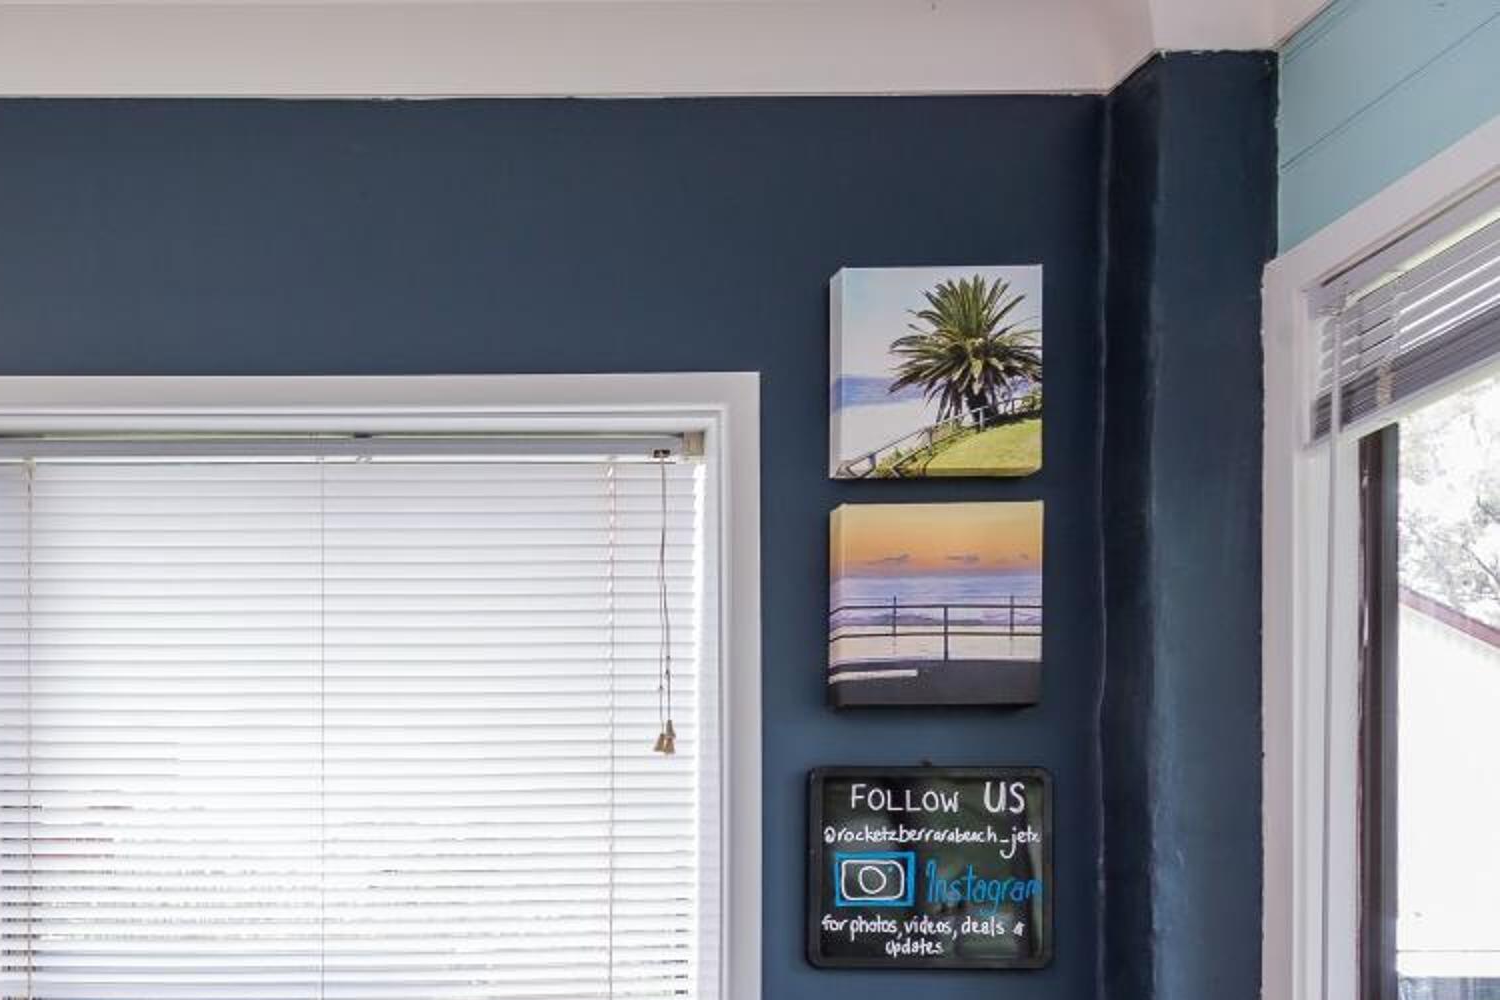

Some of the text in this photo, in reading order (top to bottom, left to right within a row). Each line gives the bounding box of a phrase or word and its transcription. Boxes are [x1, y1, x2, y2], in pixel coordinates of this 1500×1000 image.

[850, 781, 1026, 814] FOLLOW US
[821, 914, 848, 931] for
[849, 914, 902, 942] photos,
[904, 914, 957, 941] videos,
[961, 915, 1005, 937] deals
